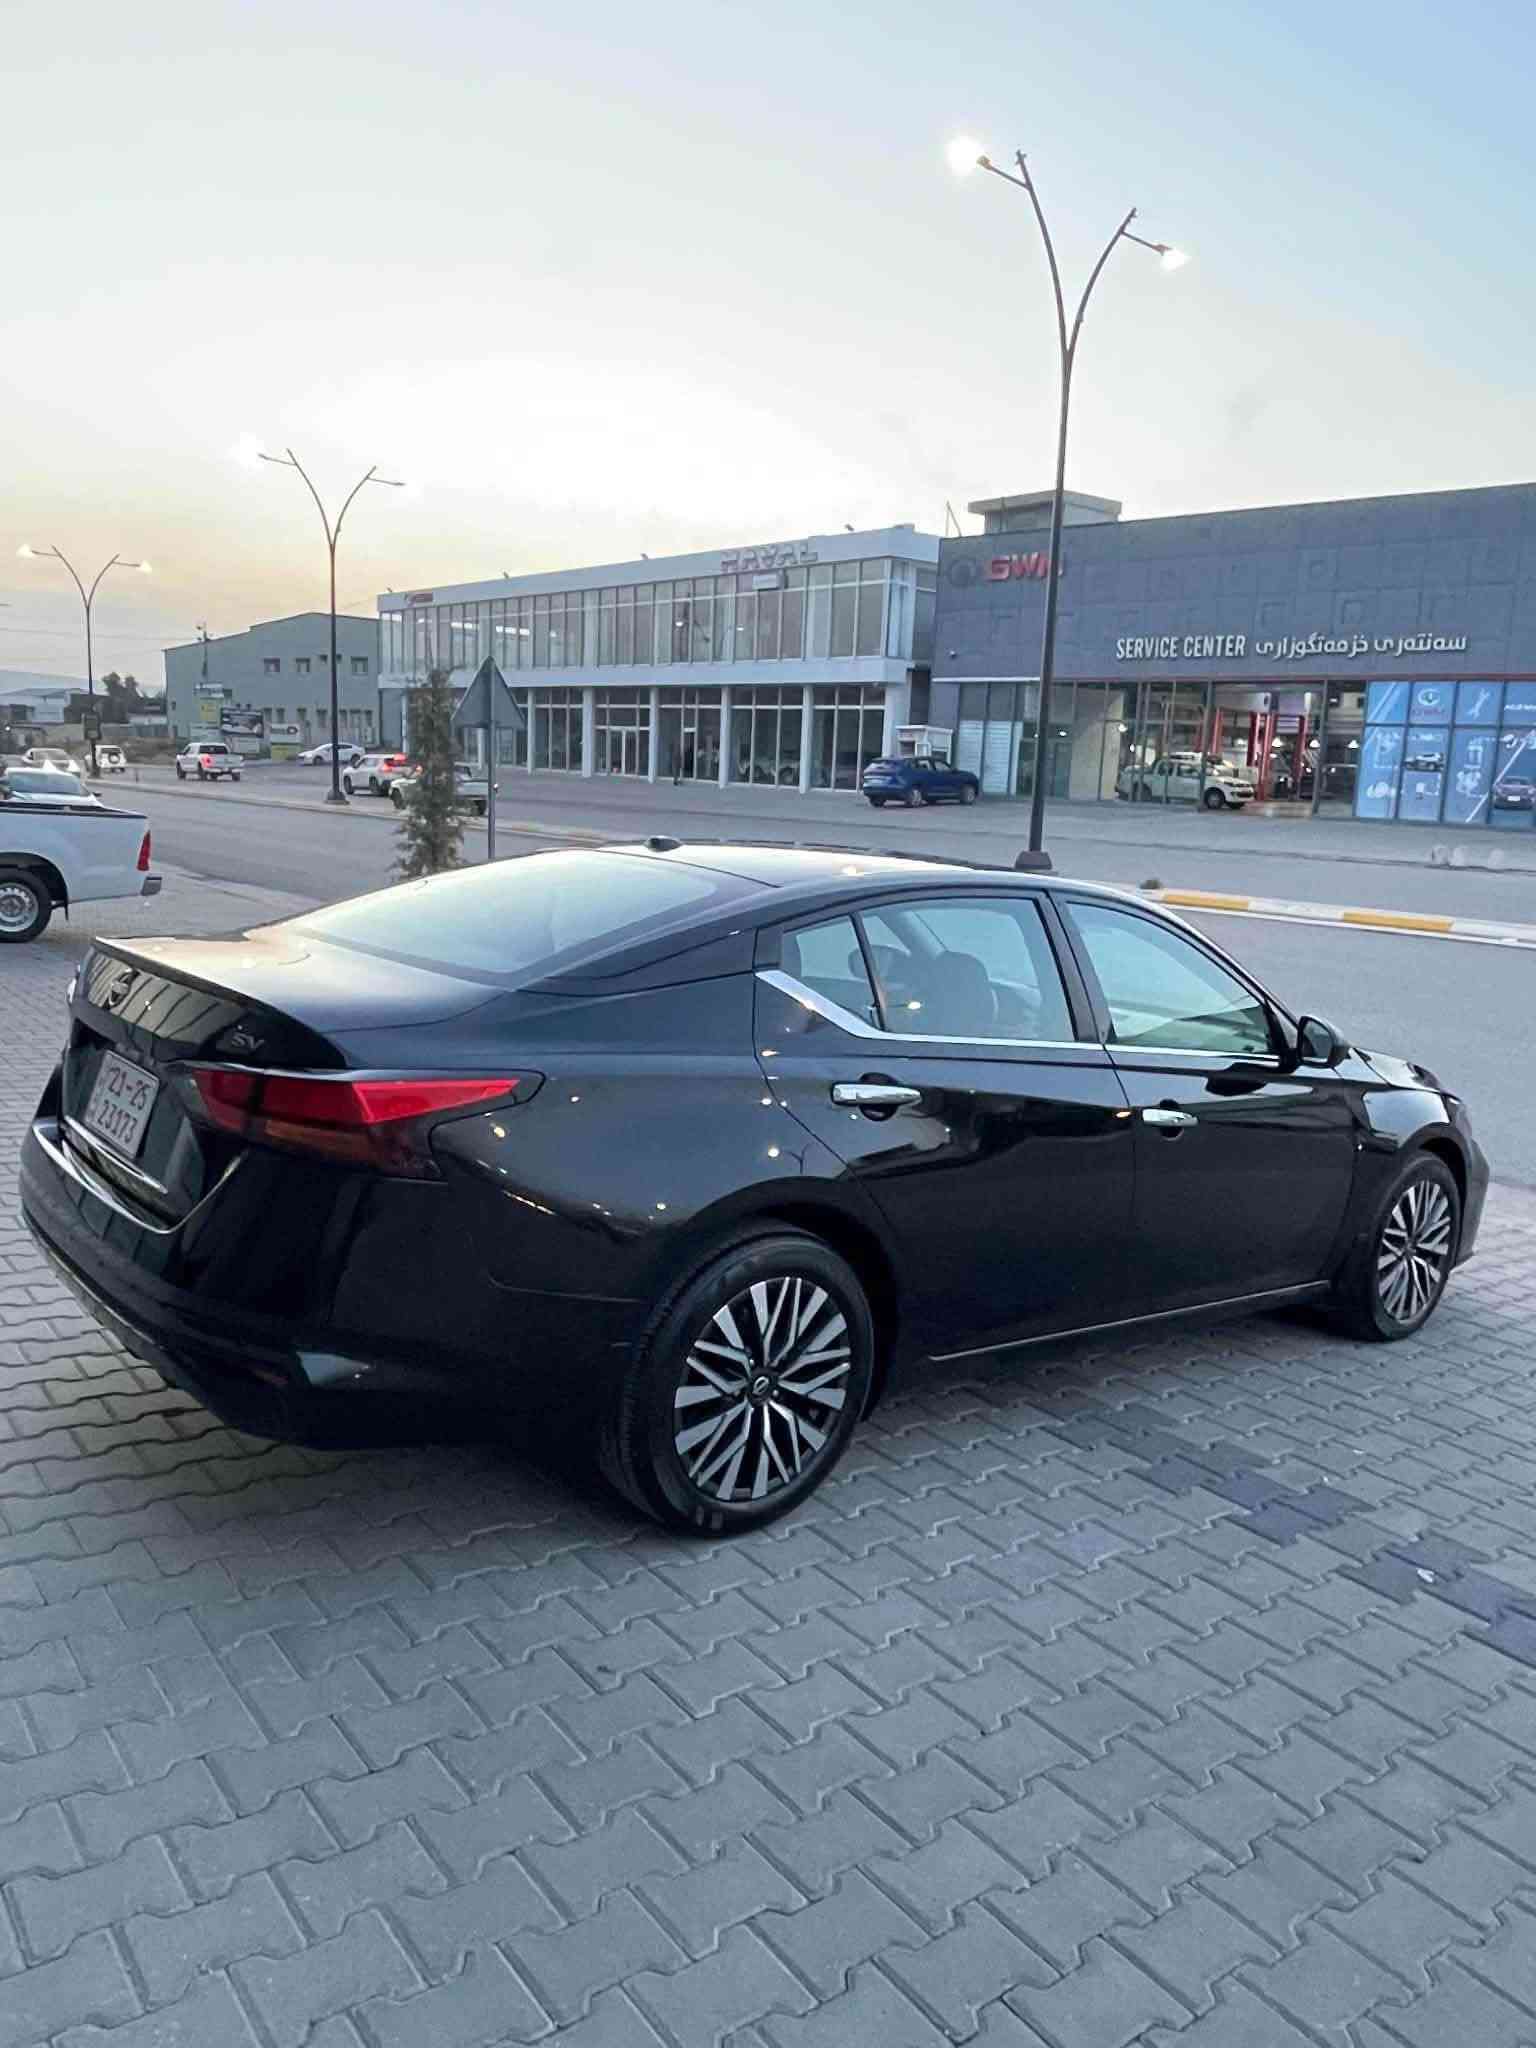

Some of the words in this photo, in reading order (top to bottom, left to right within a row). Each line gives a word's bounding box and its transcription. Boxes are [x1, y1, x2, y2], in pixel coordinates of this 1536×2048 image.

[1115, 636, 1180, 660] SERVICE
[1183, 634, 1247, 658] CENTER
[231, 1031, 266, 1050] SV
